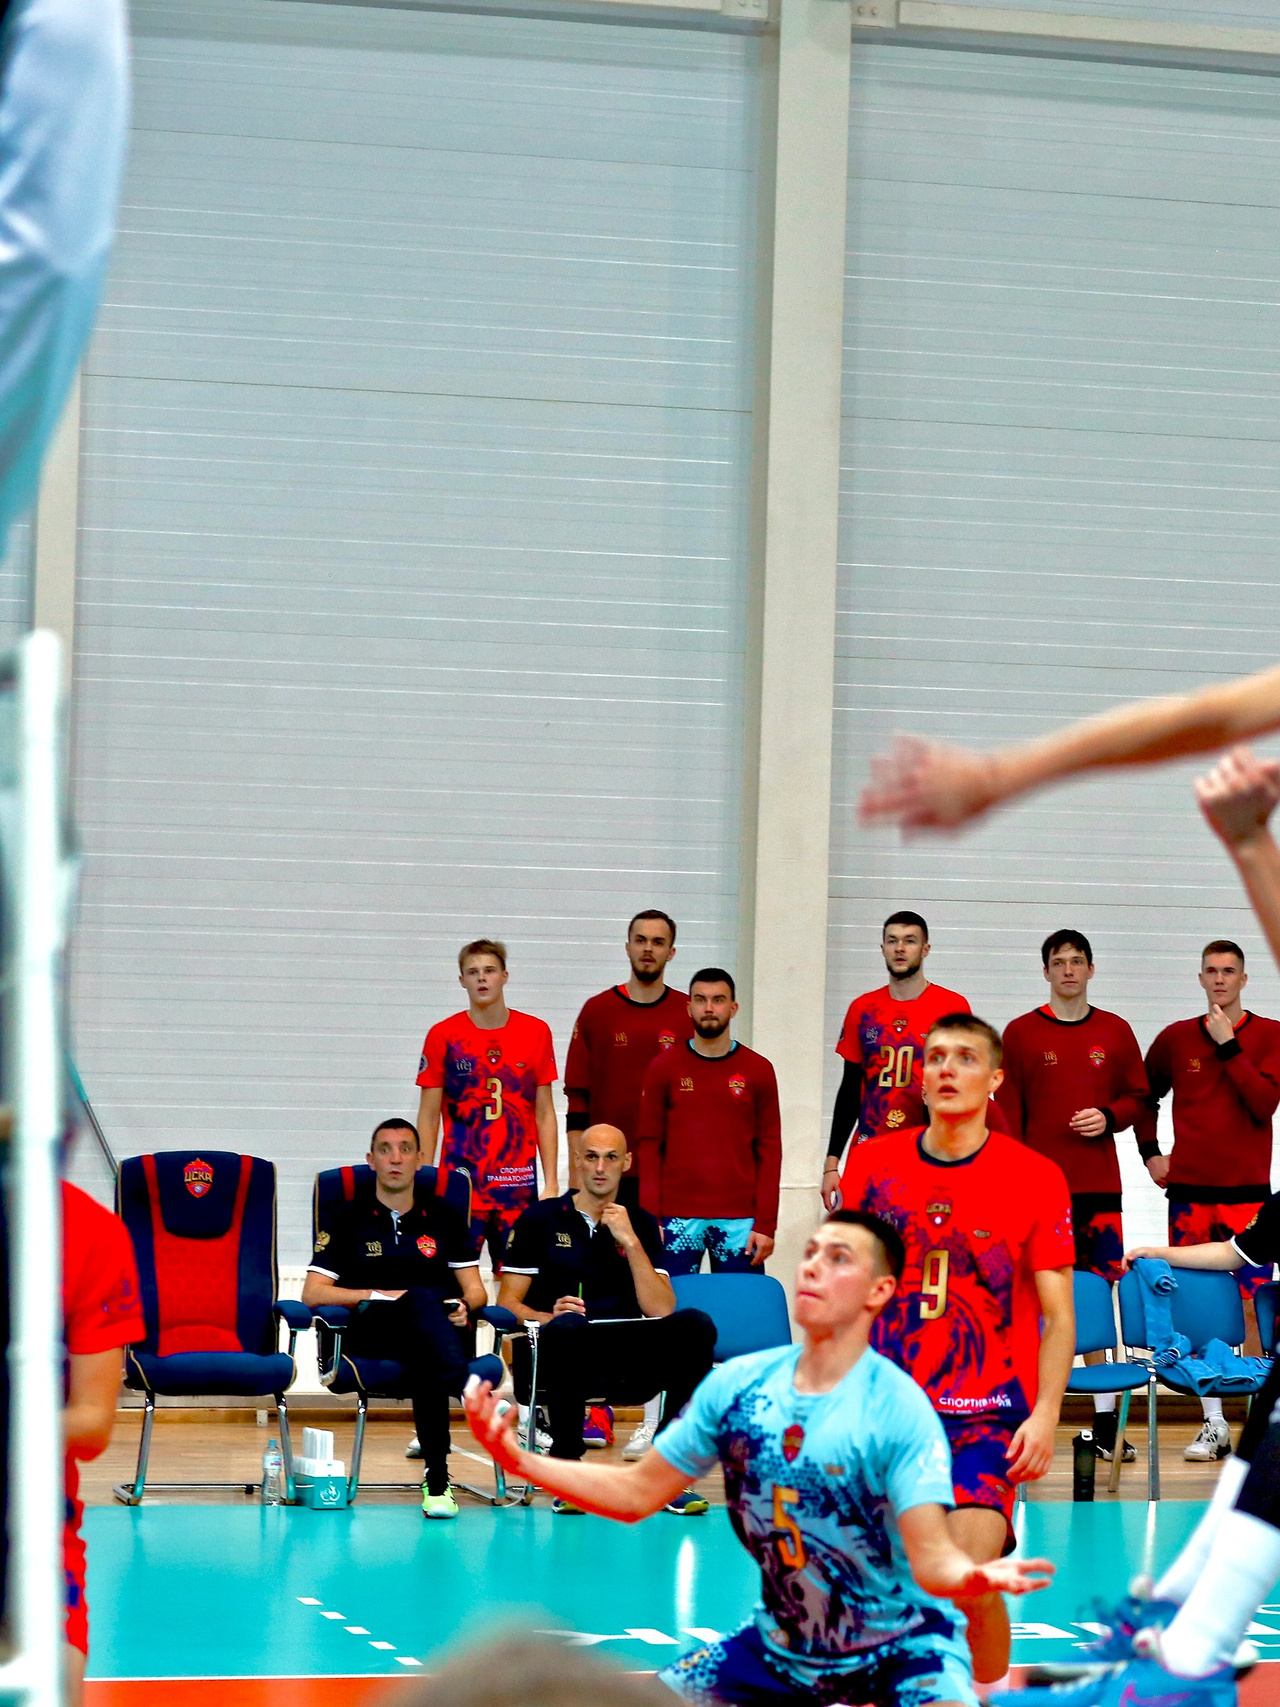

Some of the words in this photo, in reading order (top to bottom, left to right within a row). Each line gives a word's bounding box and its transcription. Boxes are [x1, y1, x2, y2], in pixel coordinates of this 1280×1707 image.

[878, 1045, 914, 1087] 20
[485, 1077, 503, 1121] 3
[184, 1171, 213, 1182] ЦСКА
[919, 1250, 949, 1320] 9
[772, 1484, 807, 1570] 5
